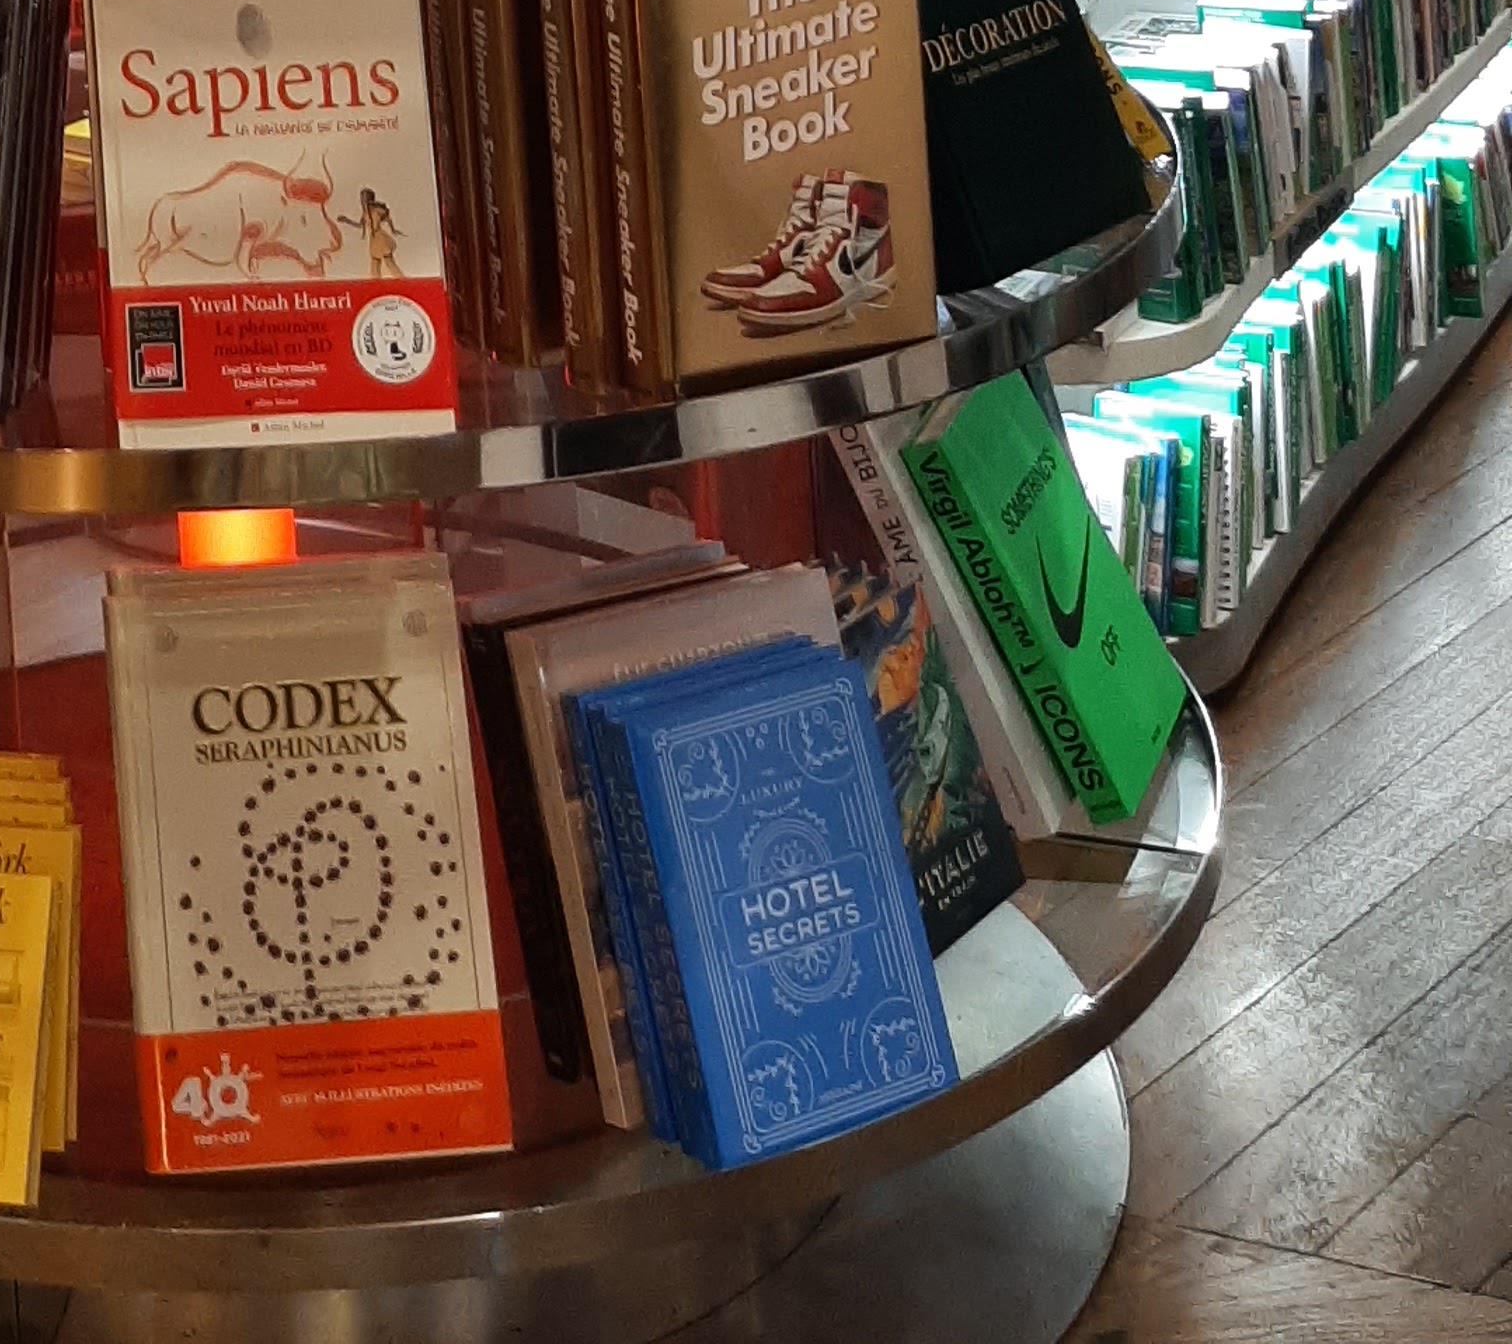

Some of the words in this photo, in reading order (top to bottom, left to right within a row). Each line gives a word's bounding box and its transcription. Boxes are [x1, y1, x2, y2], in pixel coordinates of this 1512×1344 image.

[120, 49, 401, 139] Sapiens
[471, 6, 491, 127] Ultimate
[544, 19, 565, 145] Ultimate
[607, 31, 626, 158] Ultimate
[699, 41, 879, 129] Sneaker
[741, 91, 851, 164] Book
[552, 150, 574, 274] Sneaker
[614, 162, 637, 289] Sneaker
[188, 294, 239, 314] Yuval
[241, 293, 290, 312] Noah
[294, 291, 352, 311] Harari
[215, 320, 234, 338] Le
[561, 274, 582, 349] Book
[622, 287, 644, 365] Book
[307, 335, 333, 353] BD
[919, 450, 973, 531] Virgil
[1032, 682, 1104, 793] ICONS
[193, 675, 407, 735] CODEX
[195, 729, 407, 765] SERAPHINIANUS
[739, 868, 855, 928] HOTEL
[747, 902, 862, 958] SECRETS
